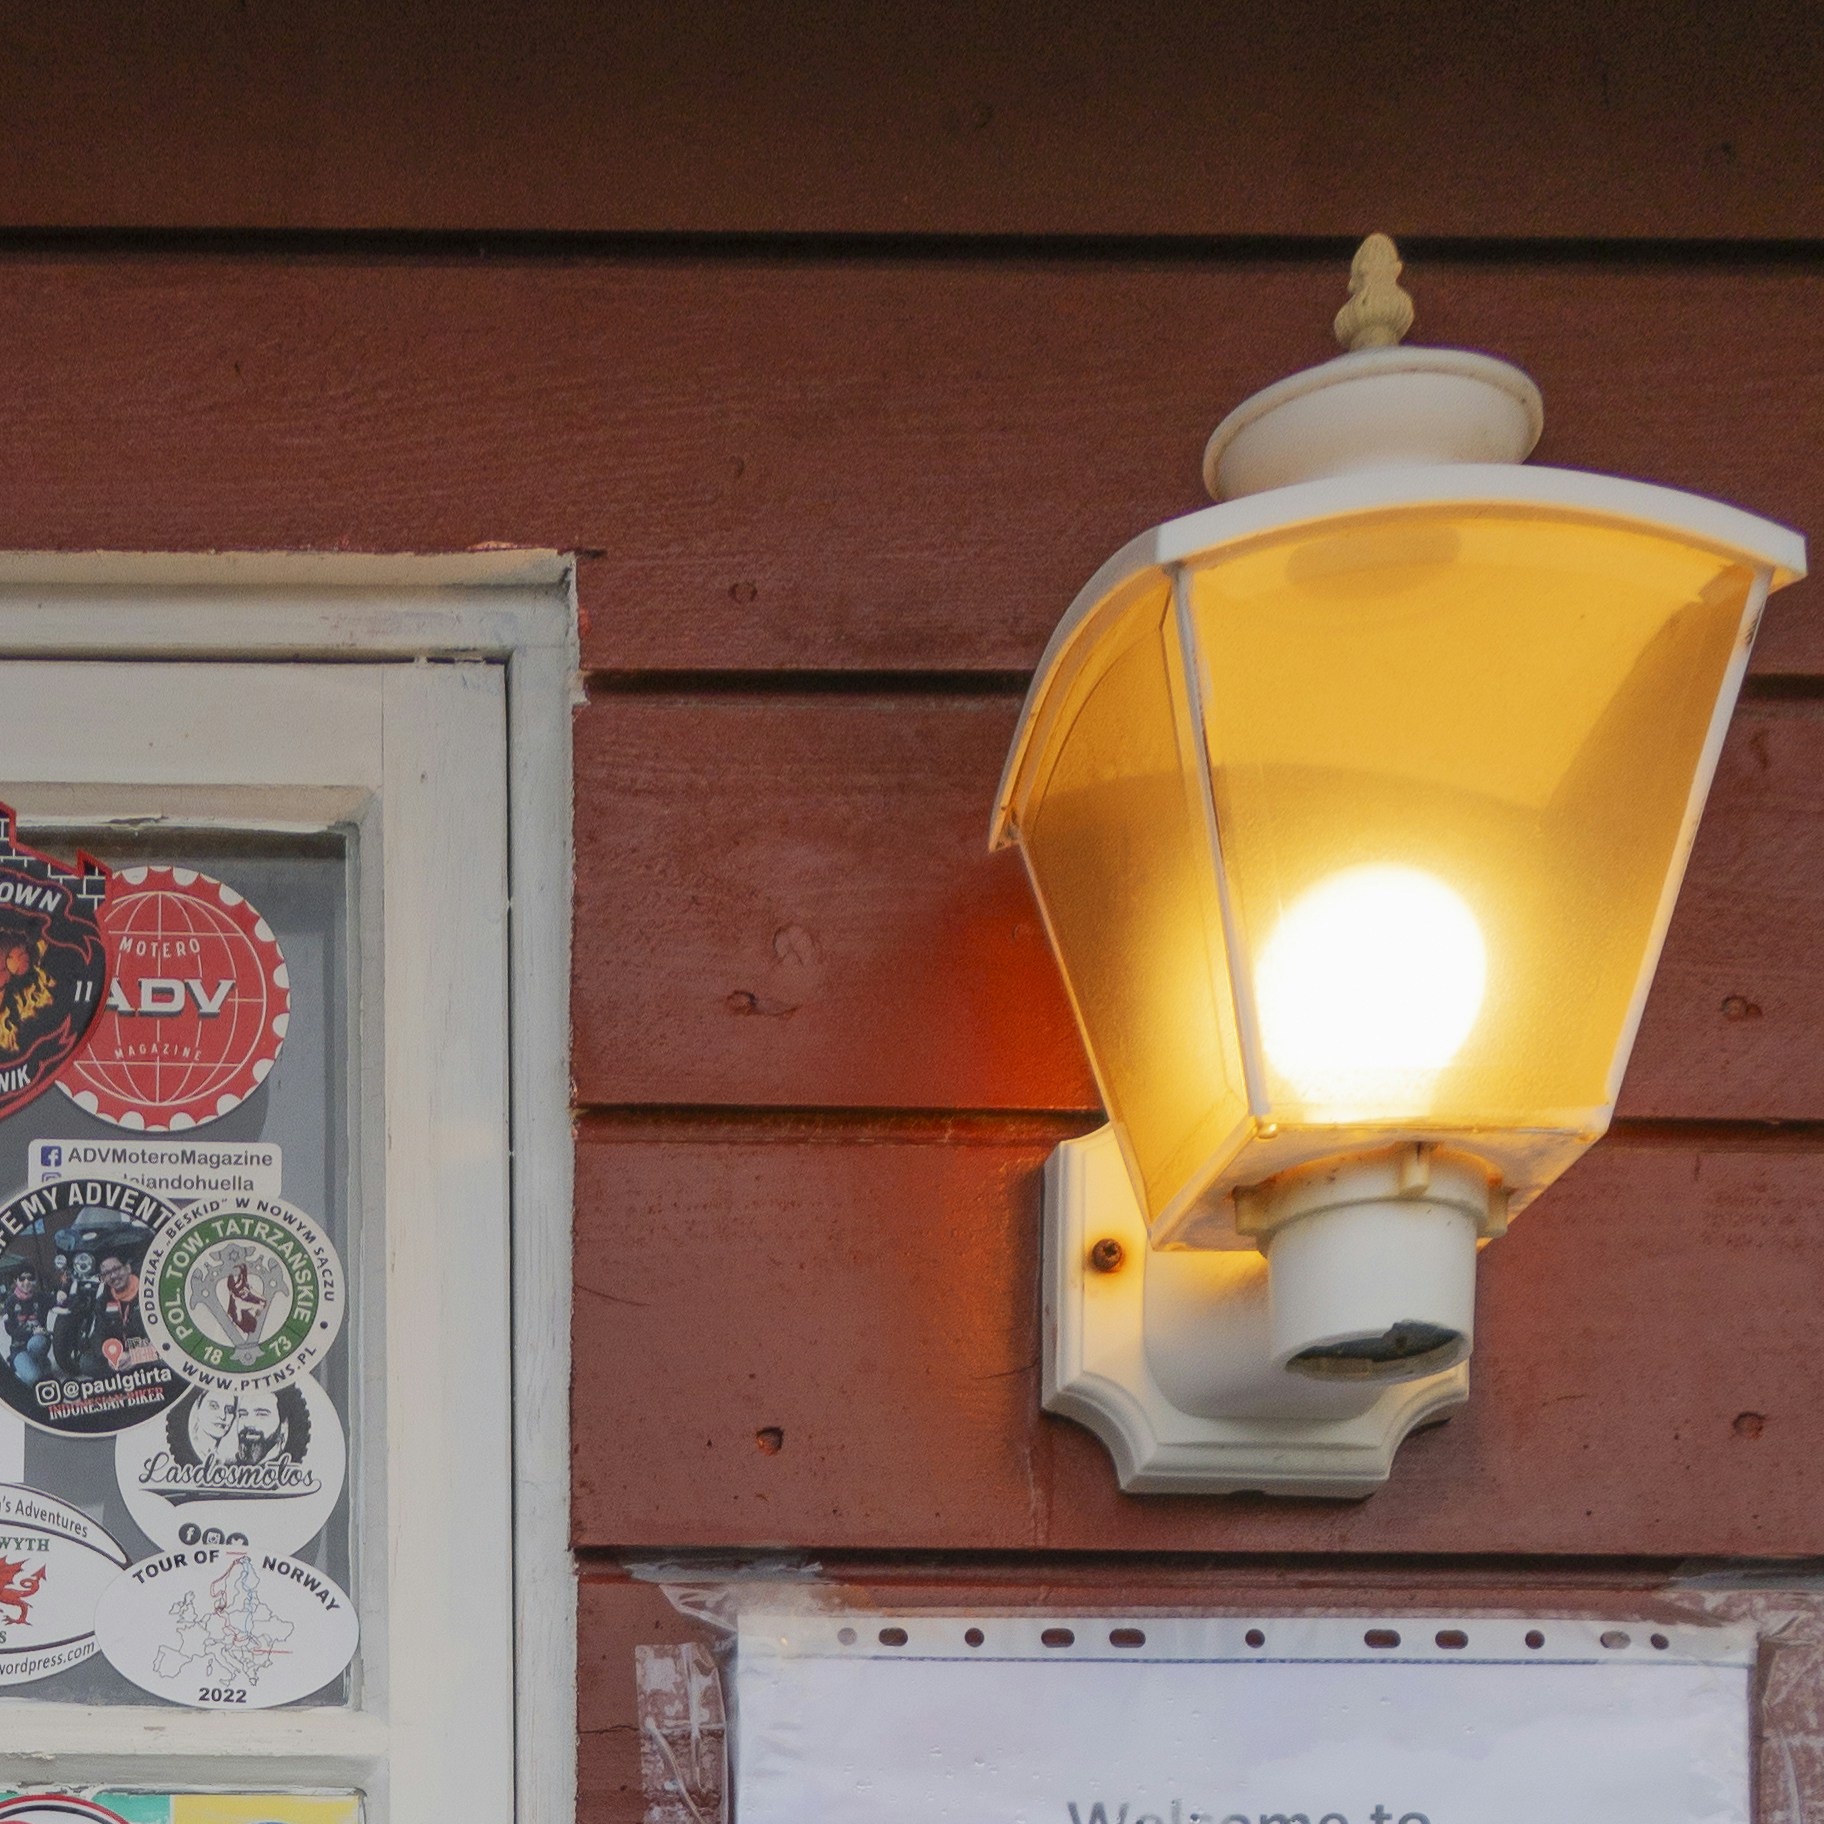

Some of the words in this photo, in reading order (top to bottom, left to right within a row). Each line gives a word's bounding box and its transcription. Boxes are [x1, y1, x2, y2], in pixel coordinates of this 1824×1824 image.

[68, 1147, 273, 1167] ADVMoteroMagazine
[62, 1369, 172, 1398] @paulgtirta
[14, 1500, 89, 1538] Adventures
[198, 1688, 246, 1703] 2022
